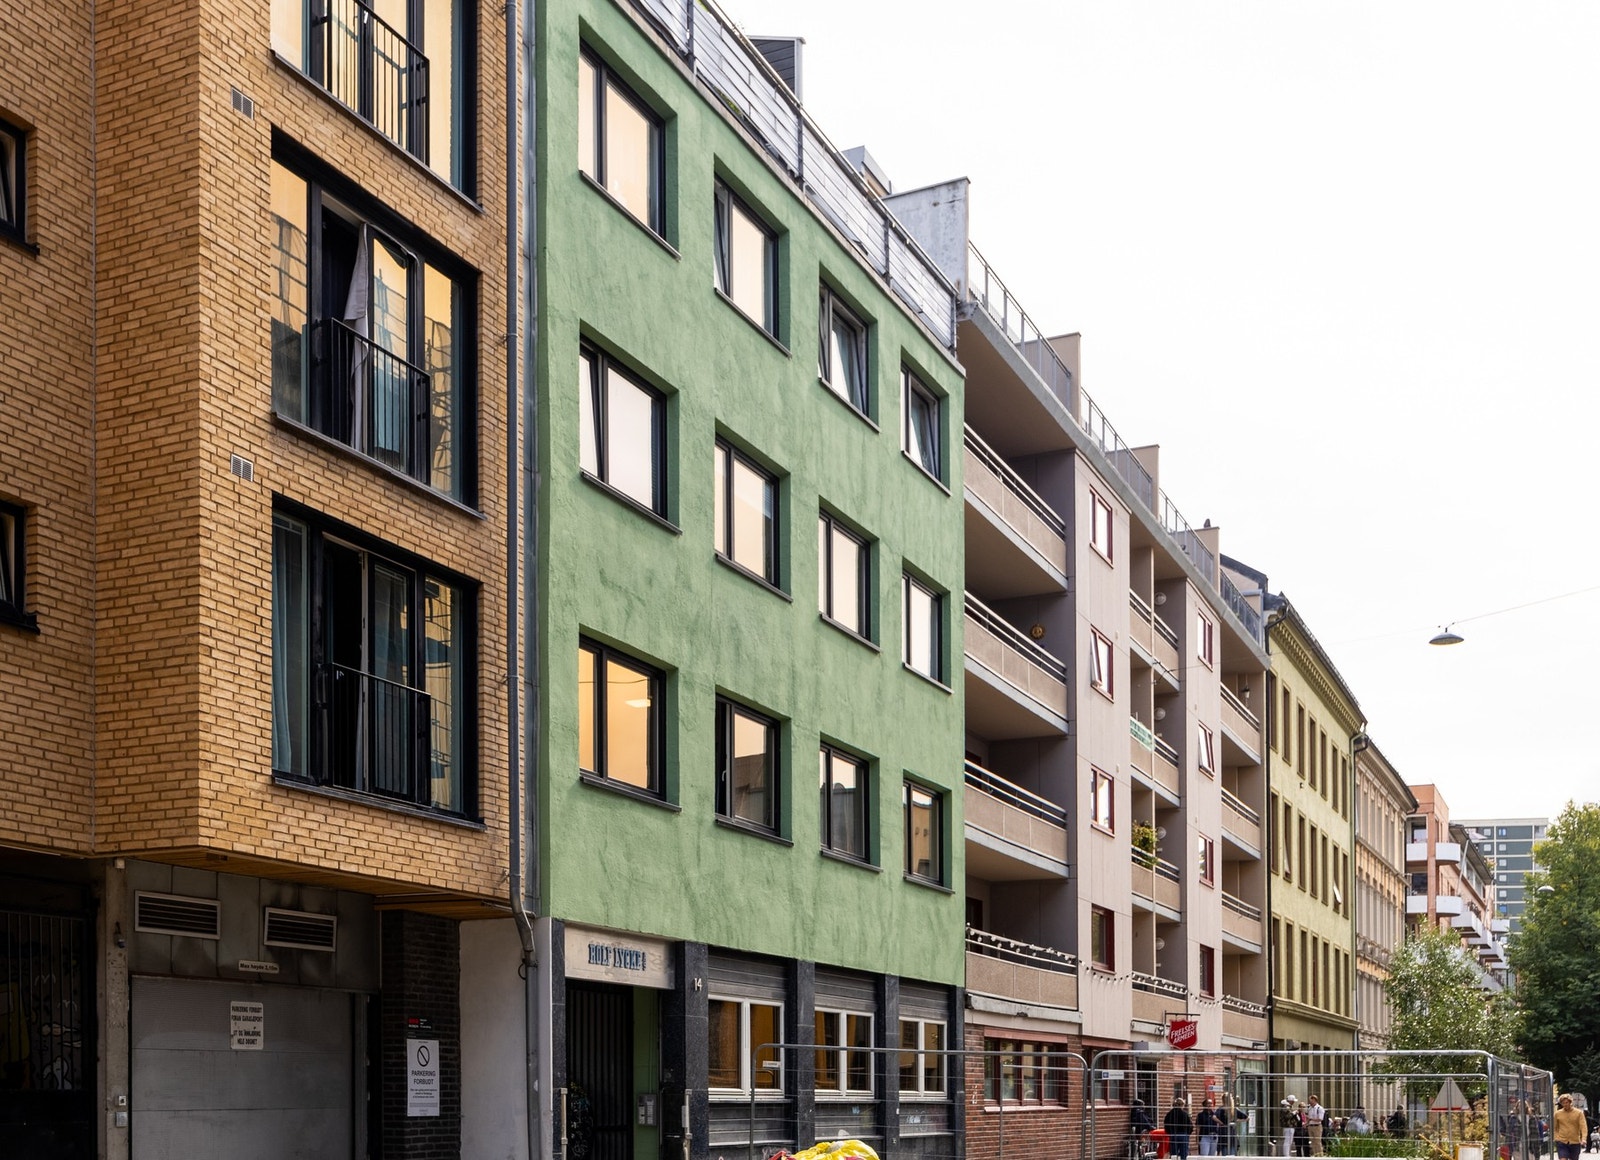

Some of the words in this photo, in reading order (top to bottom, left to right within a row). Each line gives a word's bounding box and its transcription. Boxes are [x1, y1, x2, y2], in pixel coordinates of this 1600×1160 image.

[588, 943, 612, 967] ROLF
[613, 947, 641, 971] LYCKE
[694, 977, 703, 991] 14
[1173, 1030, 1194, 1044] ARMEEN
